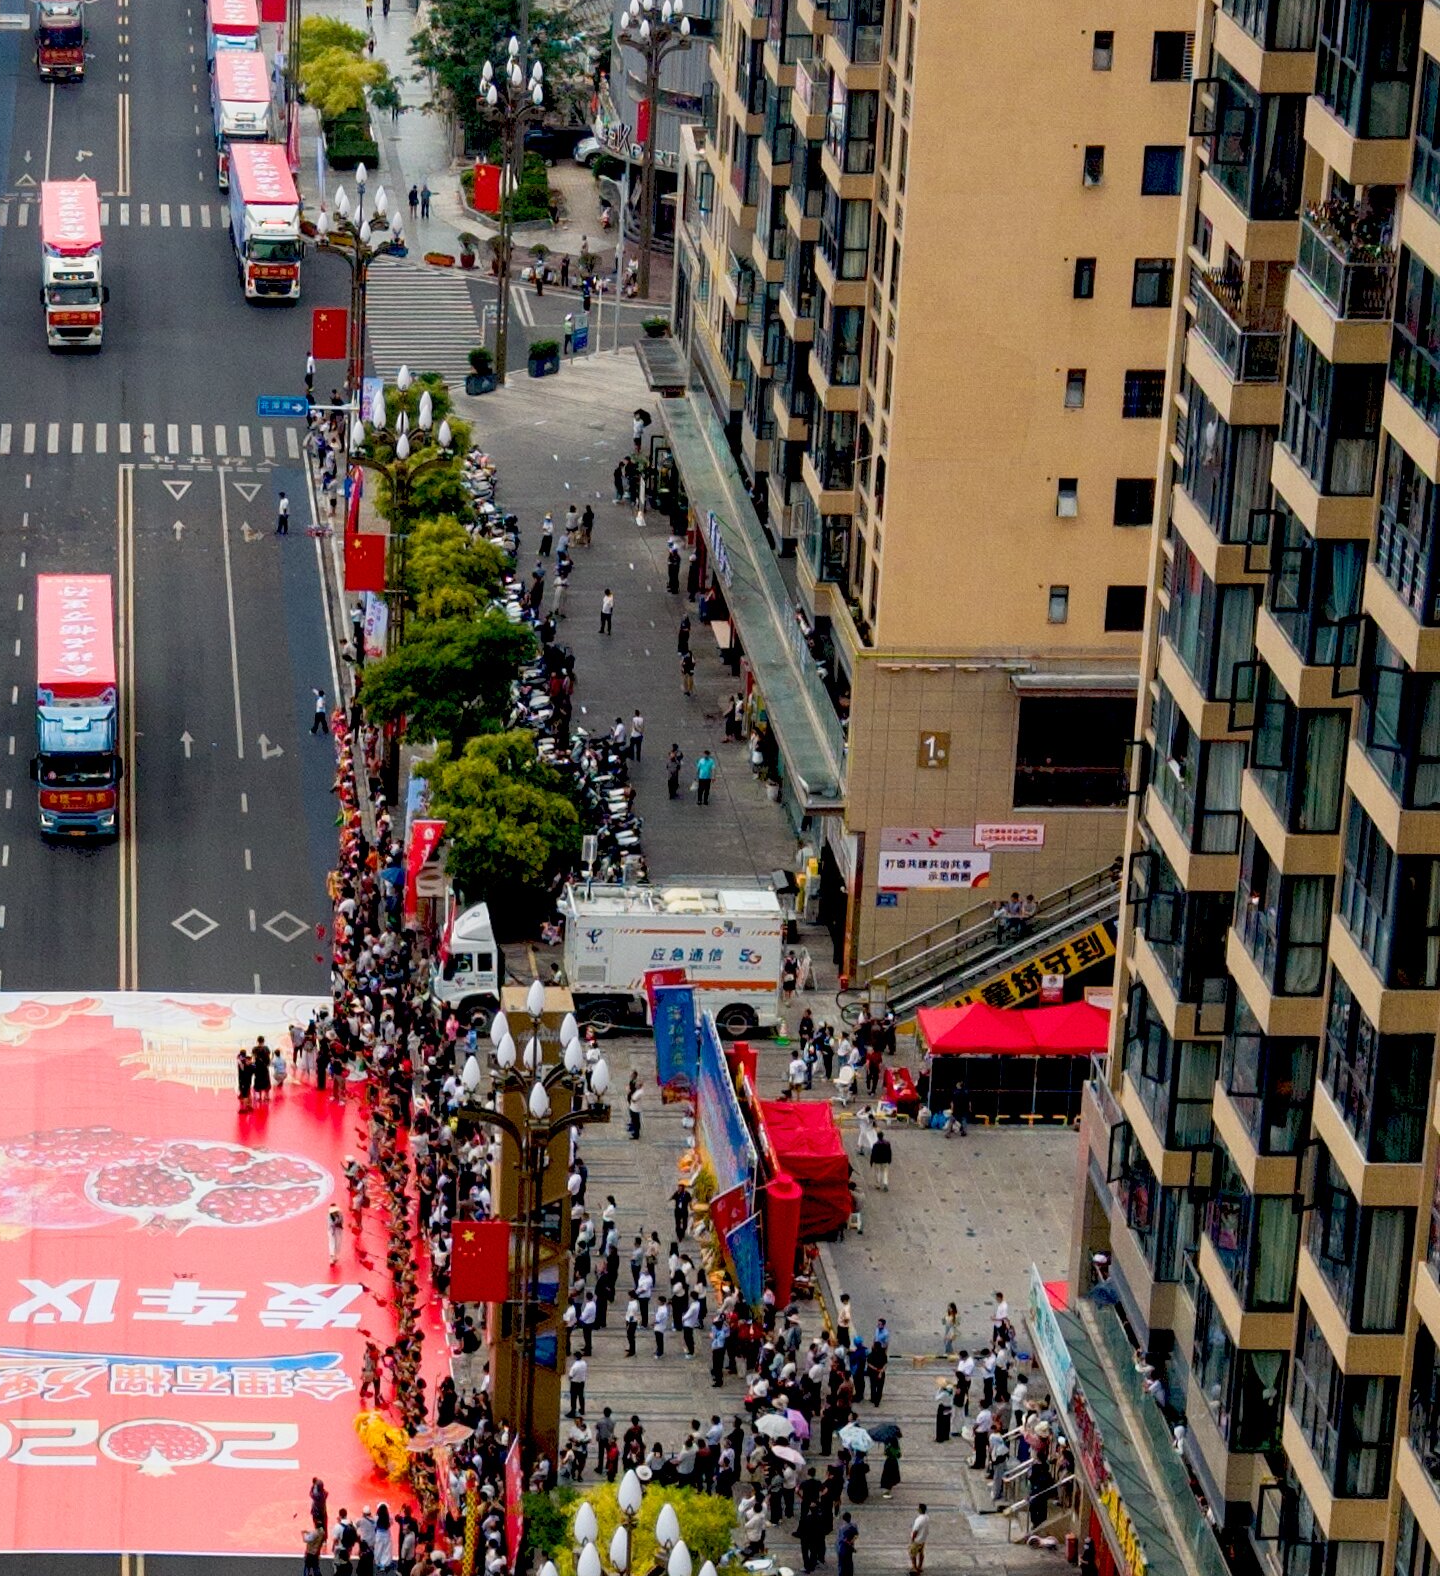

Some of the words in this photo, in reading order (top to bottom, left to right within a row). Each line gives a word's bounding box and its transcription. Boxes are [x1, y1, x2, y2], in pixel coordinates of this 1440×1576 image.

[651, 947, 724, 963] 应急通信
[739, 947, 762, 965] 5G
